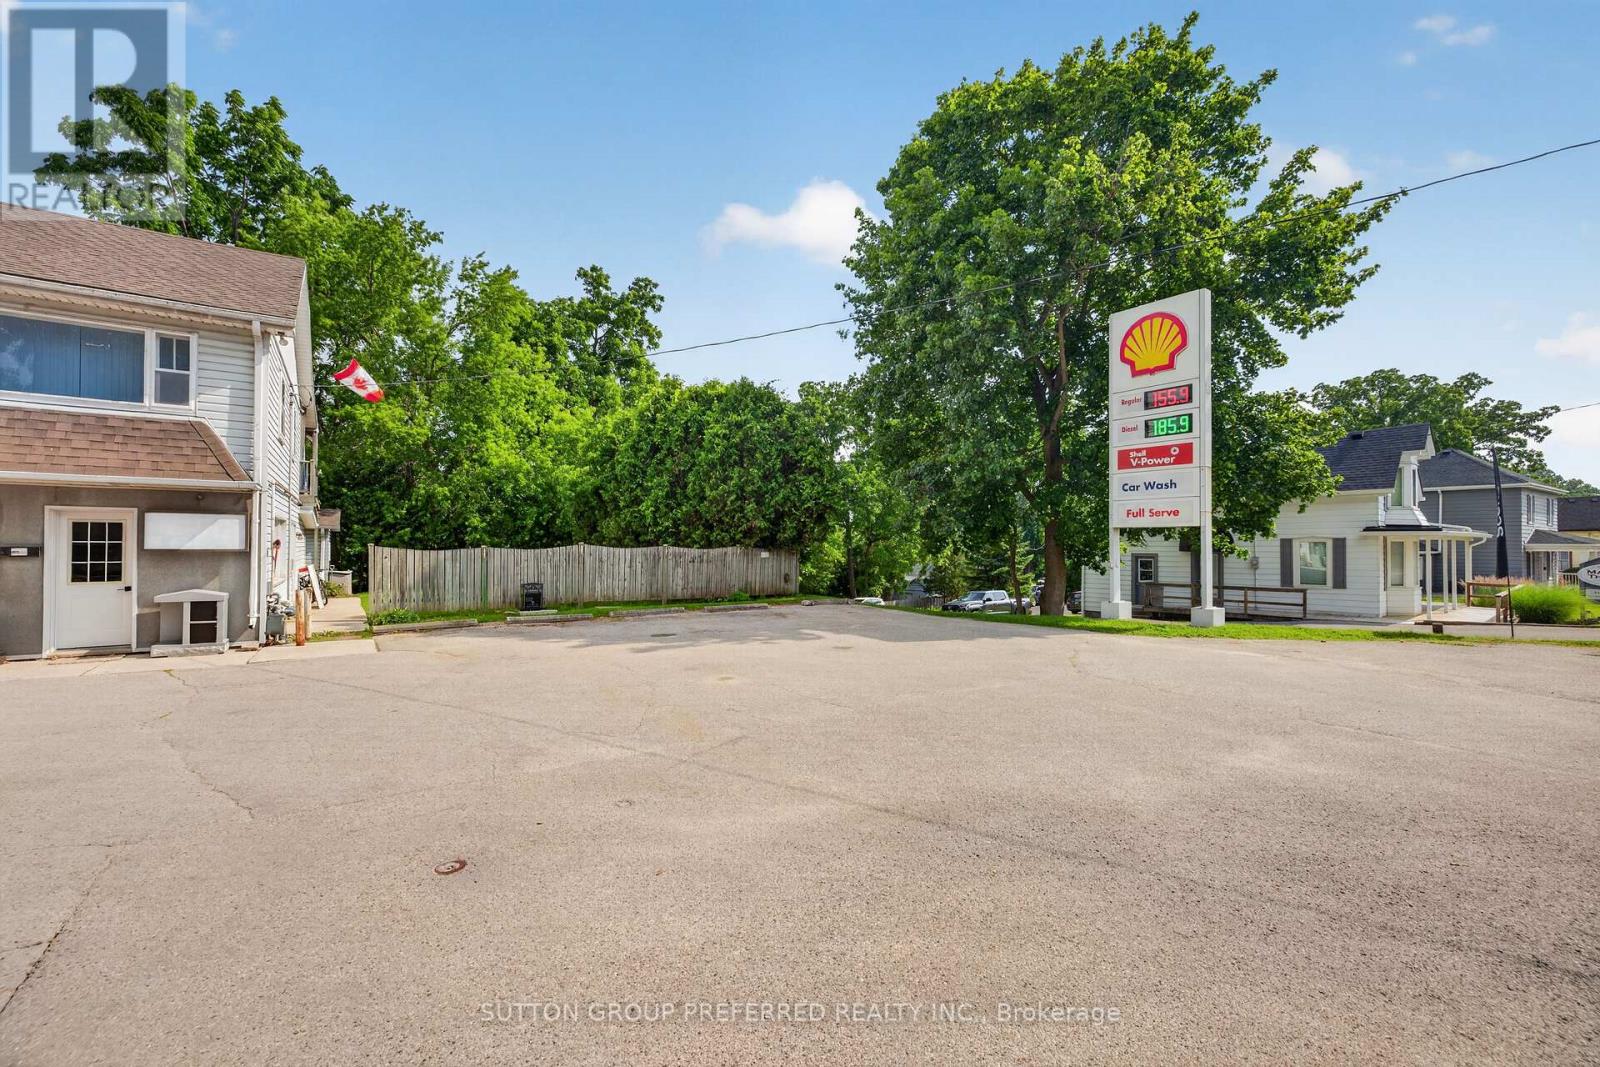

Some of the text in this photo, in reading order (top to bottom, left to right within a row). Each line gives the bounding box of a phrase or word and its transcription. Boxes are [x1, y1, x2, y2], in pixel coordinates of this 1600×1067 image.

[1121, 396, 1142, 407] Regular
[1152, 386, 1190, 408] 155.9
[1121, 424, 1138, 433] Diesel
[1152, 415, 1189, 436] 185.9
[1129, 450, 1147, 458] Shell
[1130, 456, 1176, 467] V-Power
[1122, 479, 1177, 492] Car Wash
[1126, 507, 1180, 518] Full Serve
